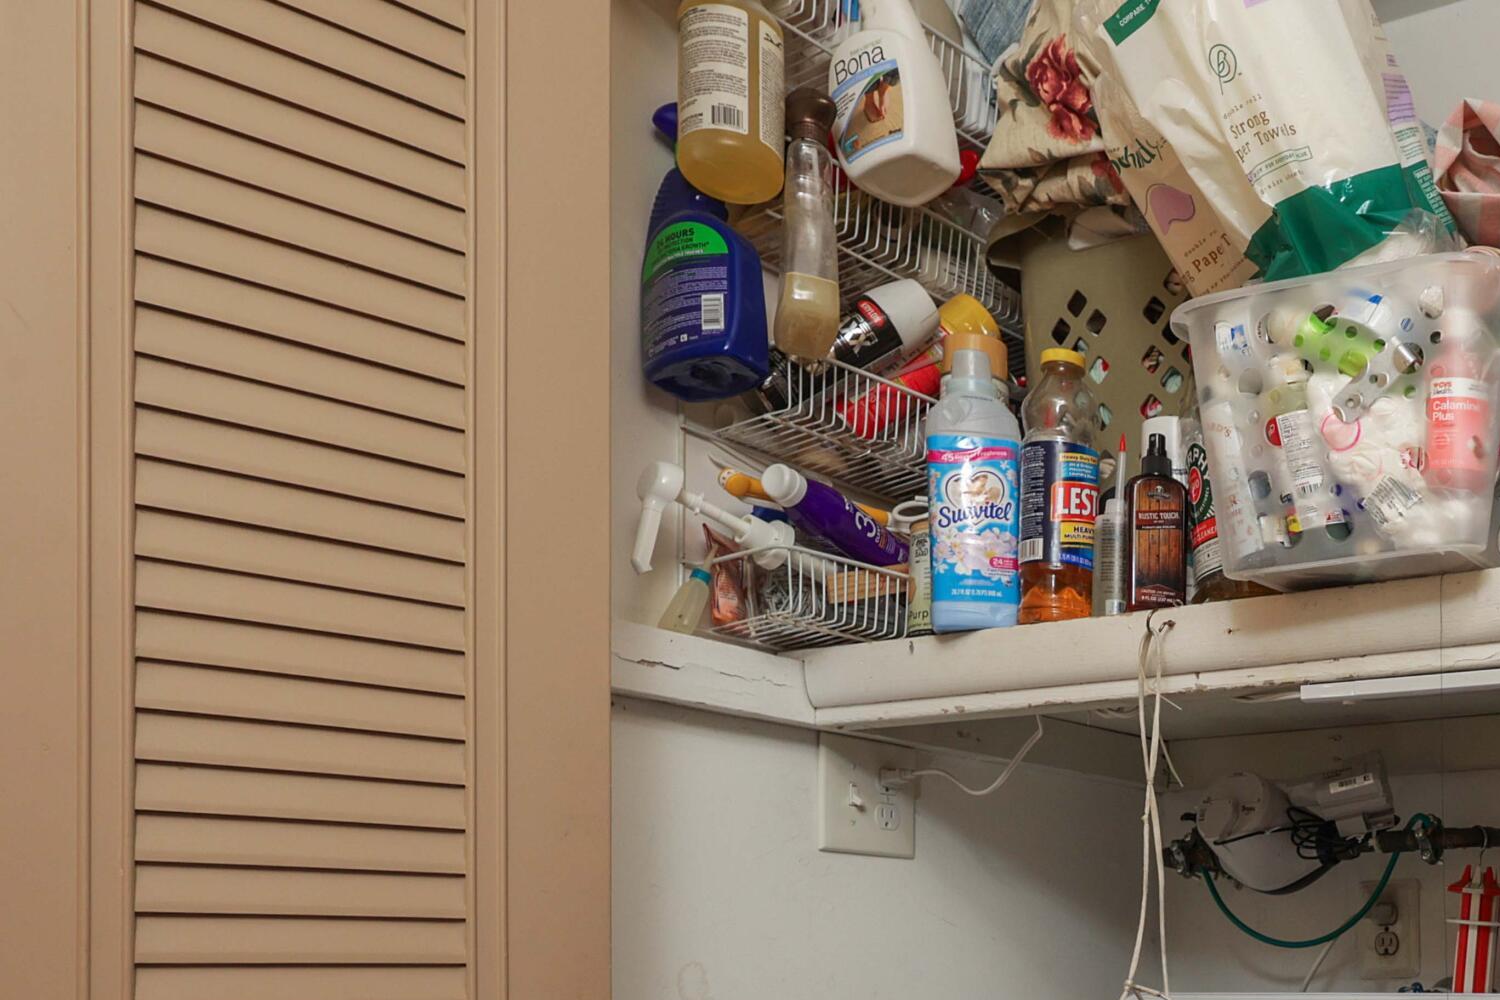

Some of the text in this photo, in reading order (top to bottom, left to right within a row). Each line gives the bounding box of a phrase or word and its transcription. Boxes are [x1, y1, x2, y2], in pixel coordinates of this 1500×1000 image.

[1119, 4, 1146, 27] COMPARE
[834, 45, 885, 85] Bona
[1229, 110, 1270, 139] Strong
[1235, 122, 1297, 163] per Towels
[1433, 412, 1455, 421] Plus
[938, 501, 1012, 528] Suavitel
[1138, 512, 1159, 520] RUSTIC
